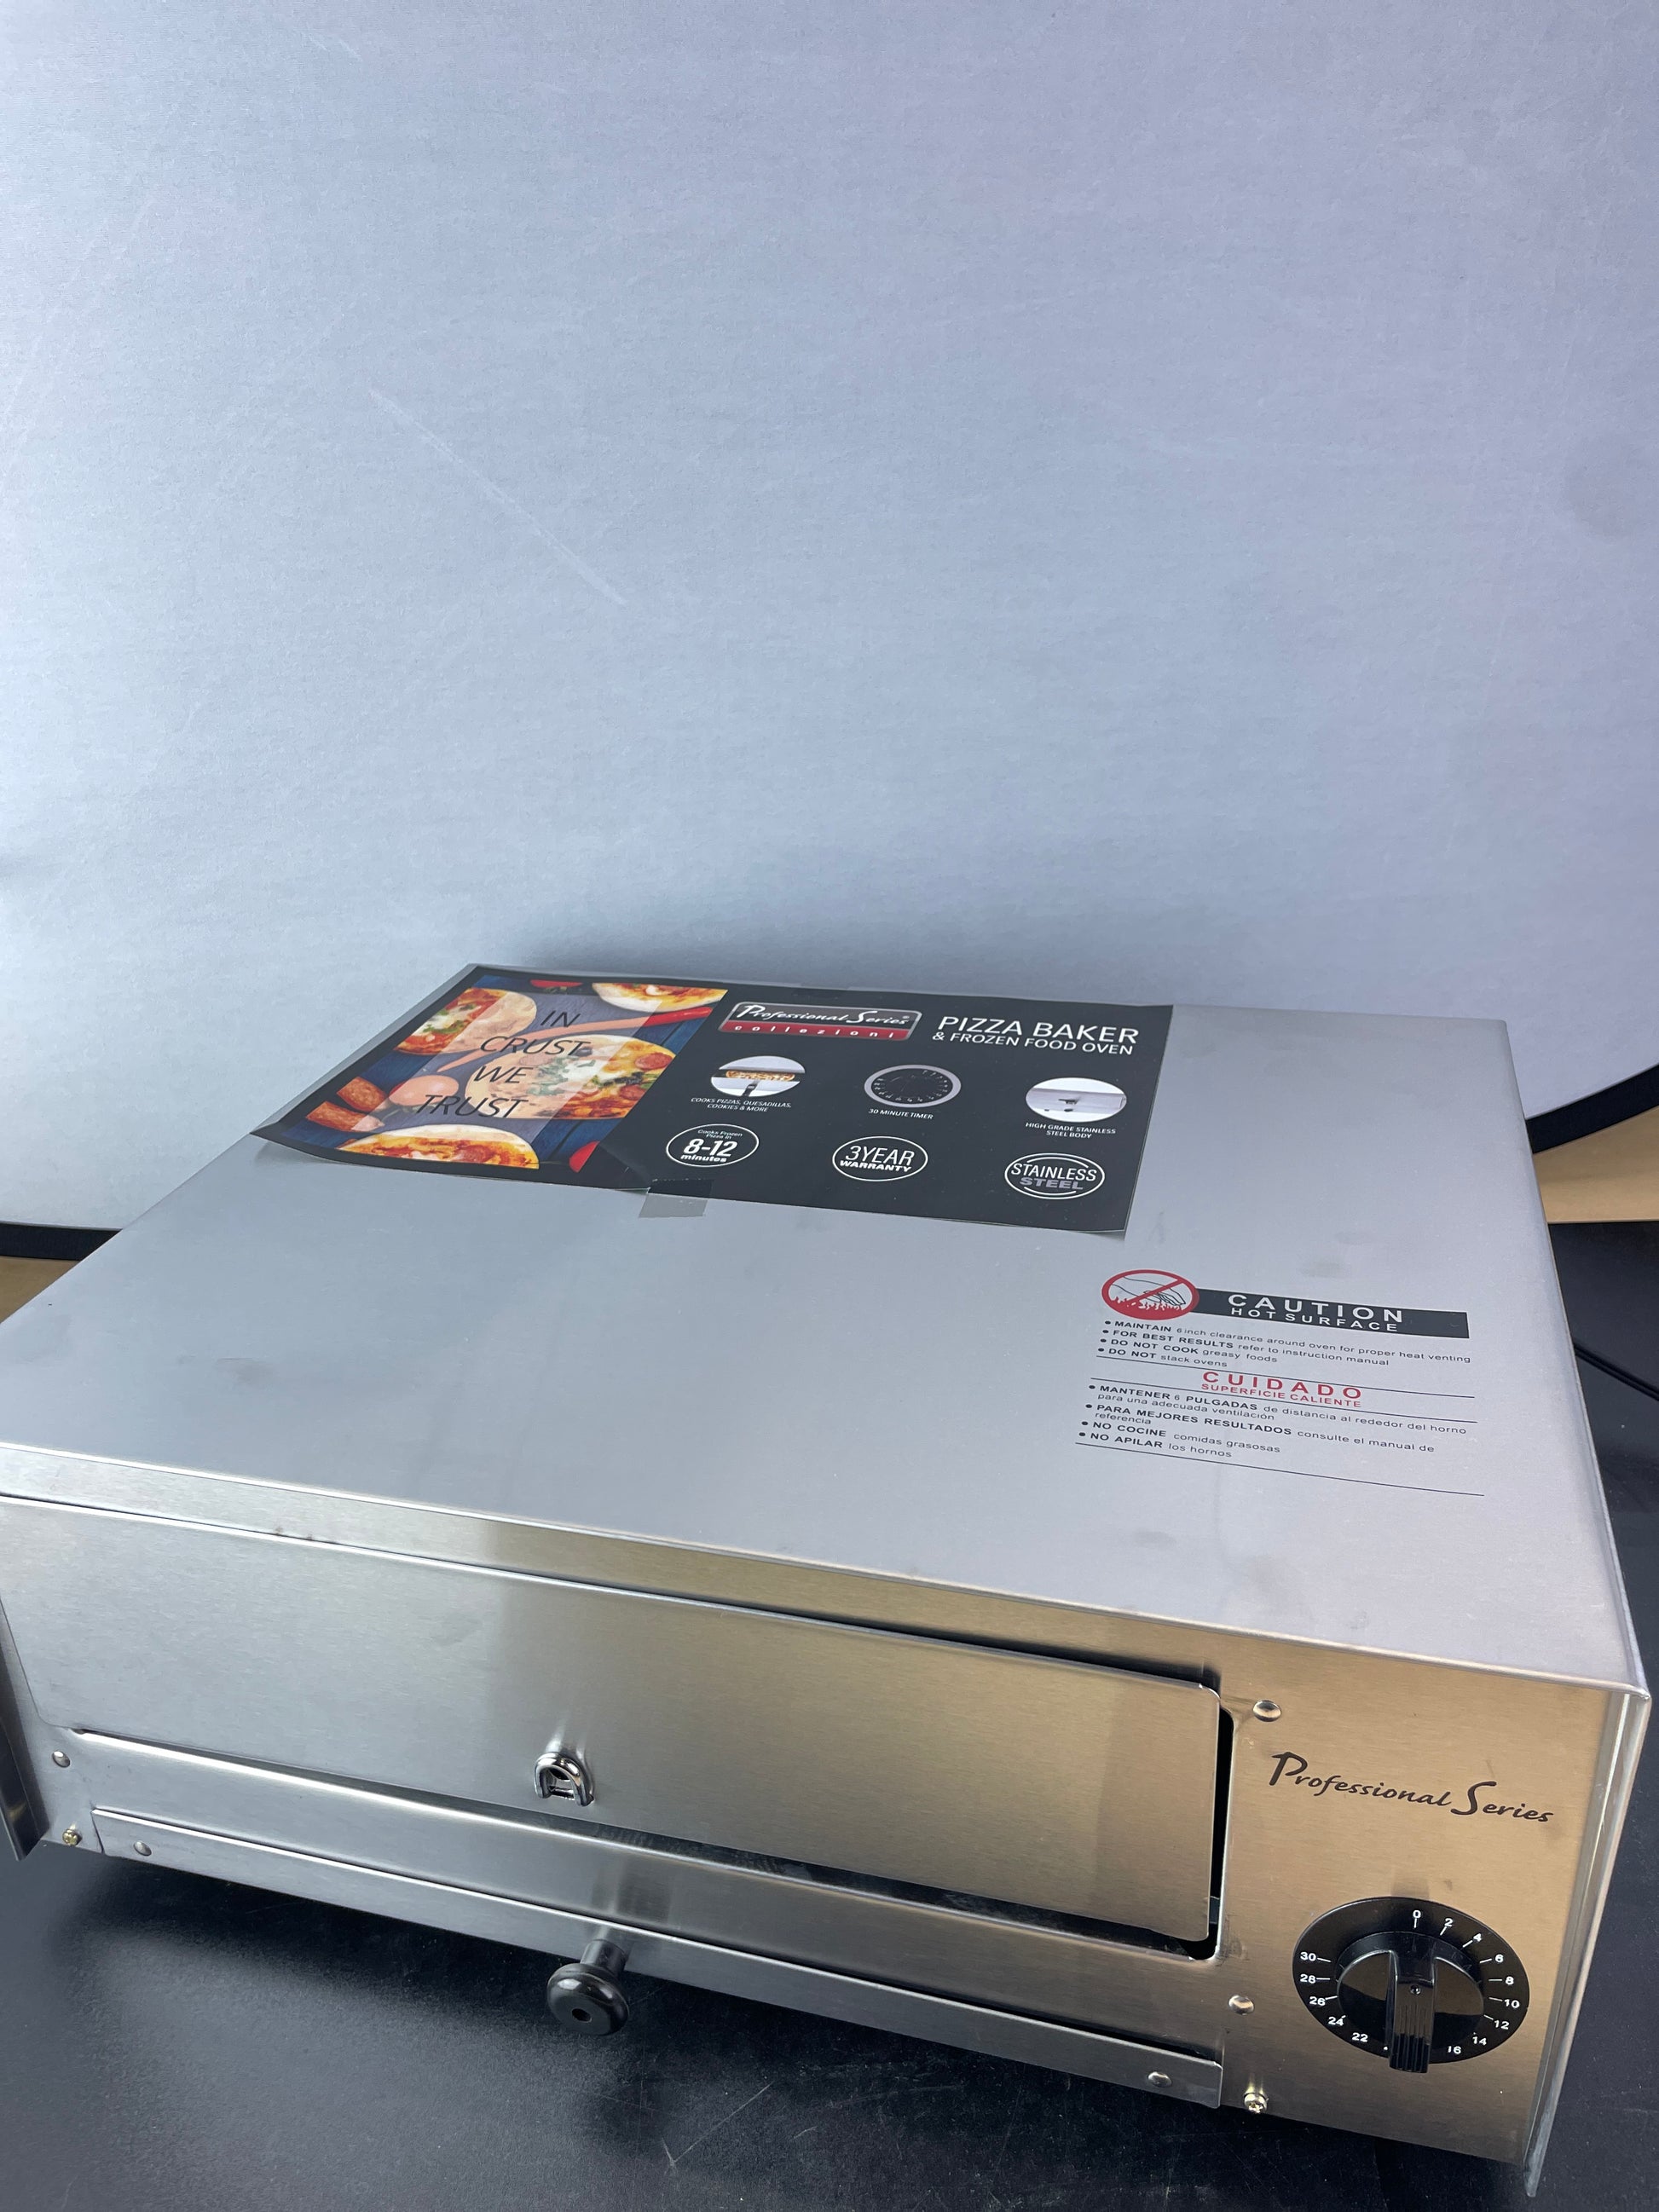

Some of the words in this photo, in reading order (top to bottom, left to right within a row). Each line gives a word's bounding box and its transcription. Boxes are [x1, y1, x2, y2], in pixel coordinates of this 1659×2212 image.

[540, 1010, 581, 1028] IN
[736, 1004, 849, 1021] Professional
[734, 1025, 894, 1038] collezioni
[938, 1016, 1023, 1036] PIZZA
[1032, 1022, 1140, 1044] BAKER
[480, 1035, 592, 1056] CRUST
[932, 1031, 945, 1041] &
[950, 1032, 1020, 1047] FROZEN
[1024, 1037, 1077, 1051] FOOD
[1082, 1042, 1133, 1055] OVEN
[473, 1066, 534, 1083] WE
[416, 1094, 529, 1118] TRUST
[743, 1100, 792, 1108] QUESADILLAS,
[879, 1109, 910, 1118] MINUTE
[910, 1112, 934, 1120] TIMER
[1075, 1126, 1117, 1135] STAINLESS
[683, 1138, 738, 1158] 8-12
[680, 1154, 727, 1163] minutes
[840, 1160, 912, 1172] WARRANTY
[1011, 1163, 1097, 1181] STAINLESS
[1020, 1177, 1084, 1190] STEEL
[1228, 1294, 1402, 1323] CAUTION
[1231, 1308, 1276, 1319] HOT
[1285, 1313, 1398, 1331] SURFACE
[1111, 1338, 1129, 1347] DO
[1133, 1341, 1159, 1349] NOT
[1163, 1344, 1199, 1354] COOK
[1202, 1349, 1240, 1359] greasy
[1246, 1353, 1278, 1363] foods
[1113, 1330, 1137, 1338] FOR
[1142, 1333, 1175, 1342] BEST
[1179, 1337, 1234, 1349] RESULTS
[1238, 1343, 1265, 1352] refer
[1282, 1348, 1343, 1360] instruction
[1346, 1355, 1389, 1366] manual
[1114, 1321, 1172, 1332] MAINTAIN
[1210, 1331, 1263, 1343] clearance
[1267, 1337, 1305, 1348] around
[1309, 1343, 1336, 1351] oven
[1358, 1348, 1396, 1357] proper
[1399, 1351, 1425, 1360] heat
[1428, 1354, 1471, 1364] venting
[1131, 1350, 1157, 1359] NOT
[1160, 1354, 1190, 1363] stack
[1194, 1359, 1228, 1367] ovens
[1203, 1371, 1361, 1400] CUIDADO
[1201, 1383, 1286, 1399] SUPERFICIE
[1290, 1394, 1361, 1407] CALIENTE
[1097, 1394, 1123, 1402] para
[1152, 1400, 1208, 1412] adecuada
[1212, 1407, 1275, 1420] ventilación
[1100, 1385, 1171, 1400] MANTENER
[1186, 1395, 1257, 1411] PULGADAS
[1263, 1405, 1278, 1413] de
[1282, 1407, 1337, 1421] distancia
[1356, 1418, 1403, 1428] rededor
[1431, 1424, 1466, 1435] horno
[1095, 1412, 1152, 1424] referencia
[1096, 1404, 1131, 1415] PARA
[1136, 1409, 1198, 1424] MEJORES
[1204, 1418, 1292, 1435] RESULTADOS
[1298, 1429, 1350, 1442] consulte
[1368, 1440, 1414, 1450] manual
[1419, 1444, 1435, 1453] de
[1090, 1433, 1109, 1441] NO
[1114, 1436, 1163, 1448] APILAR
[1168, 1443, 1186, 1452] los
[1190, 1446, 1232, 1458] hornos
[1117, 1424, 1167, 1437] COCINE
[1173, 1433, 1223, 1446] comidas
[1226, 1441, 1280, 1453] grasosas
[1268, 1751, 1452, 1808] Professional
[1450, 1781, 1554, 1822] Series
[1413, 1909, 1422, 1919] 0
[1444, 1918, 1454, 1926] 2
[1473, 1933, 1483, 1943] 4
[1300, 1951, 1316, 1961] 30
[1494, 1954, 1504, 1963] 6
[1299, 1973, 1316, 1984] 28
[1505, 1976, 1514, 1985] 8
[1309, 1995, 1326, 2006] 26
[1504, 1998, 1520, 2009] 10
[1328, 2016, 1344, 2027] 24
[1494, 2019, 1510, 2030] 12
[1351, 2032, 1368, 2042] 22
[1472, 2036, 1487, 2046] 14
[1448, 2045, 1462, 2054] 16
